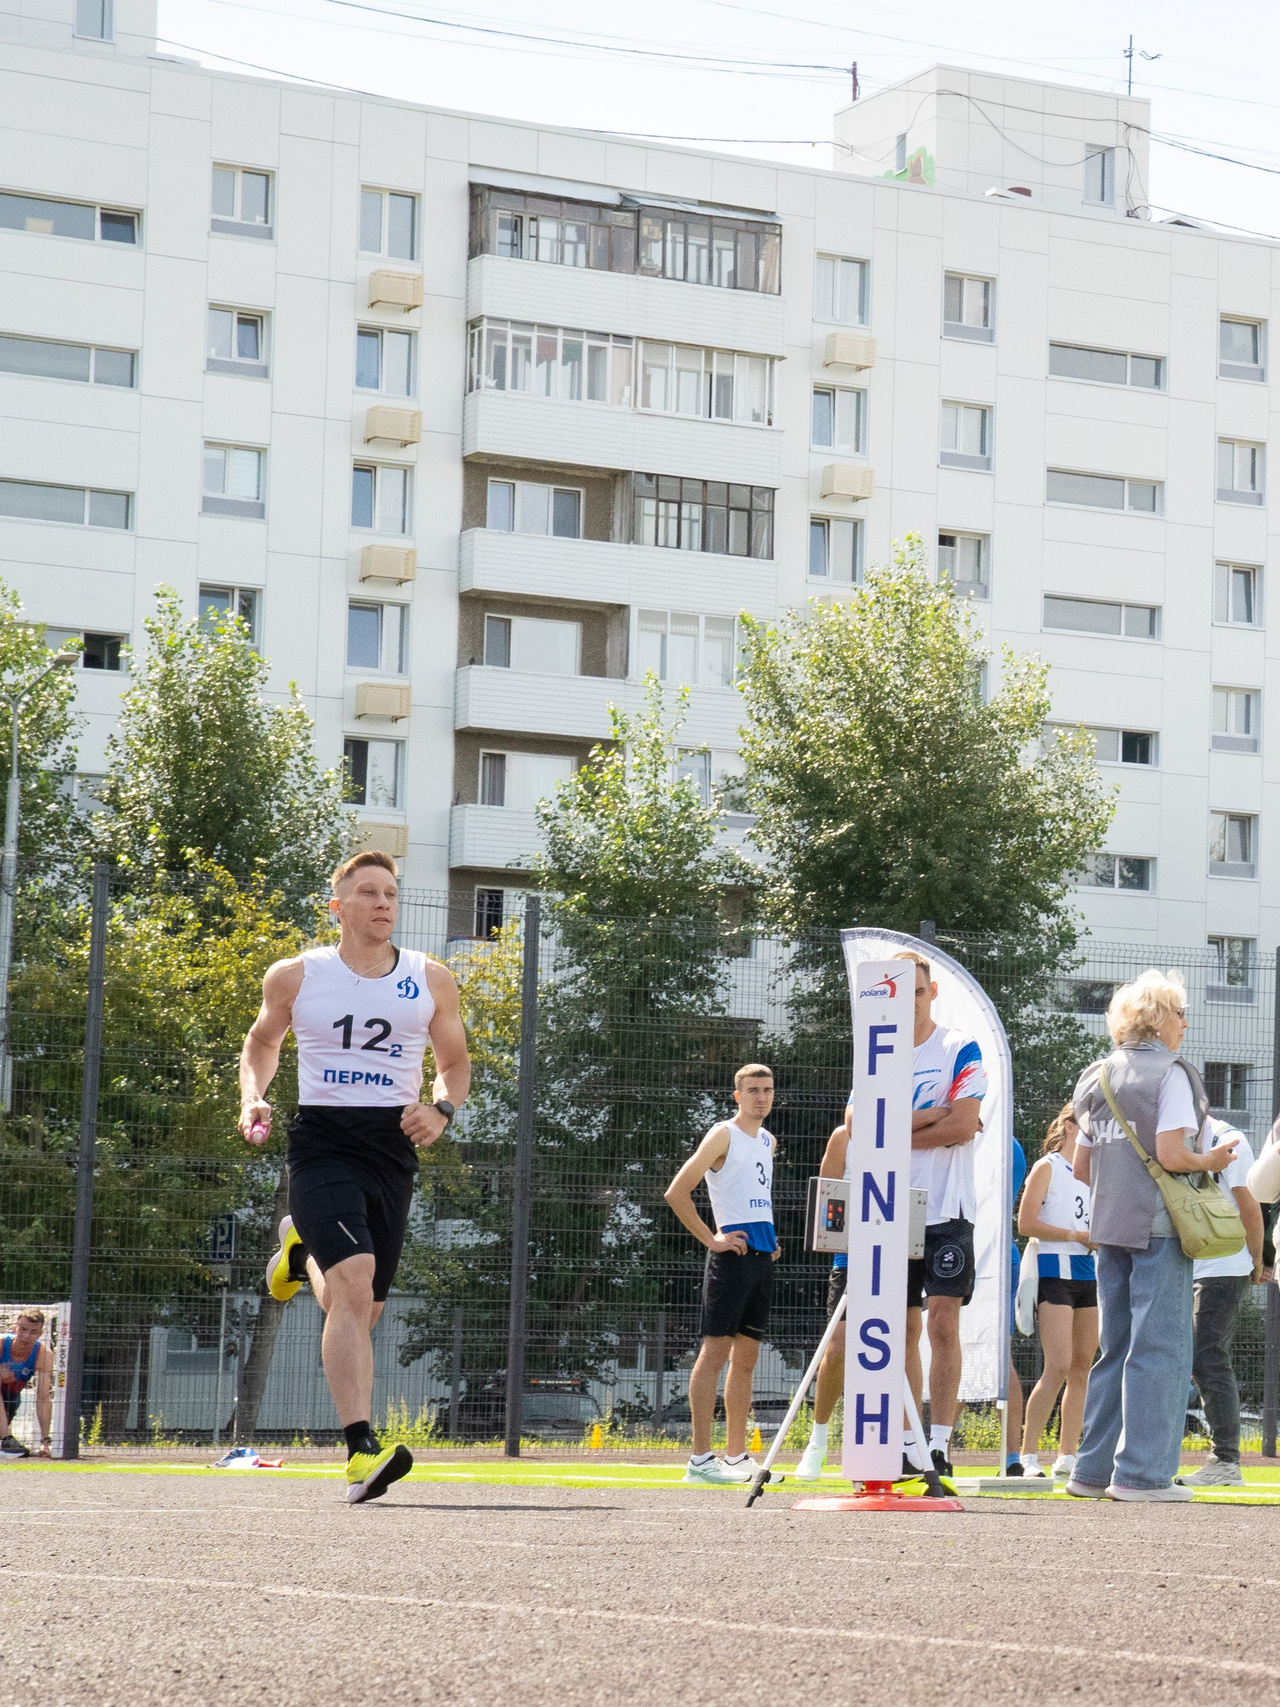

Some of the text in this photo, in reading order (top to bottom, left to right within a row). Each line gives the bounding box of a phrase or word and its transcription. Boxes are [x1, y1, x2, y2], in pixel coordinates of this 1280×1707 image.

[860, 986, 889, 999] polanik
[333, 1014, 392, 1053] 12
[323, 1069, 394, 1086] ПЕРМЬ
[855, 1024, 897, 1445] FINISH
[59, 1344, 67, 1368] SPORT
